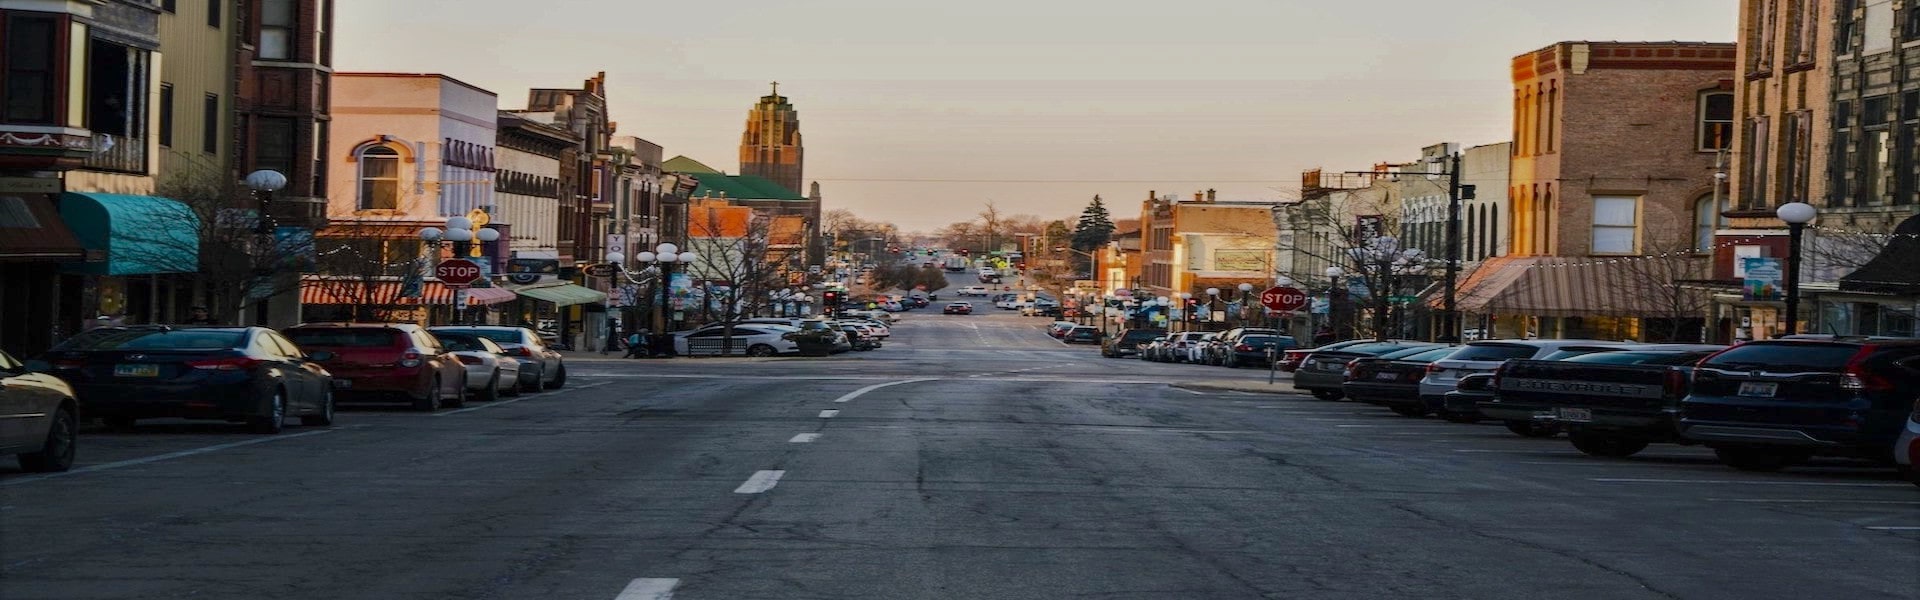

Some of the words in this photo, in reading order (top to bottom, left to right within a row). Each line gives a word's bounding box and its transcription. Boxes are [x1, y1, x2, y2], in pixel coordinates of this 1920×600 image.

[611, 236, 621, 252] YO
[438, 266, 478, 277] STOP
[1263, 293, 1303, 304] STOP
[1517, 380, 1647, 395] CHEVROLET
